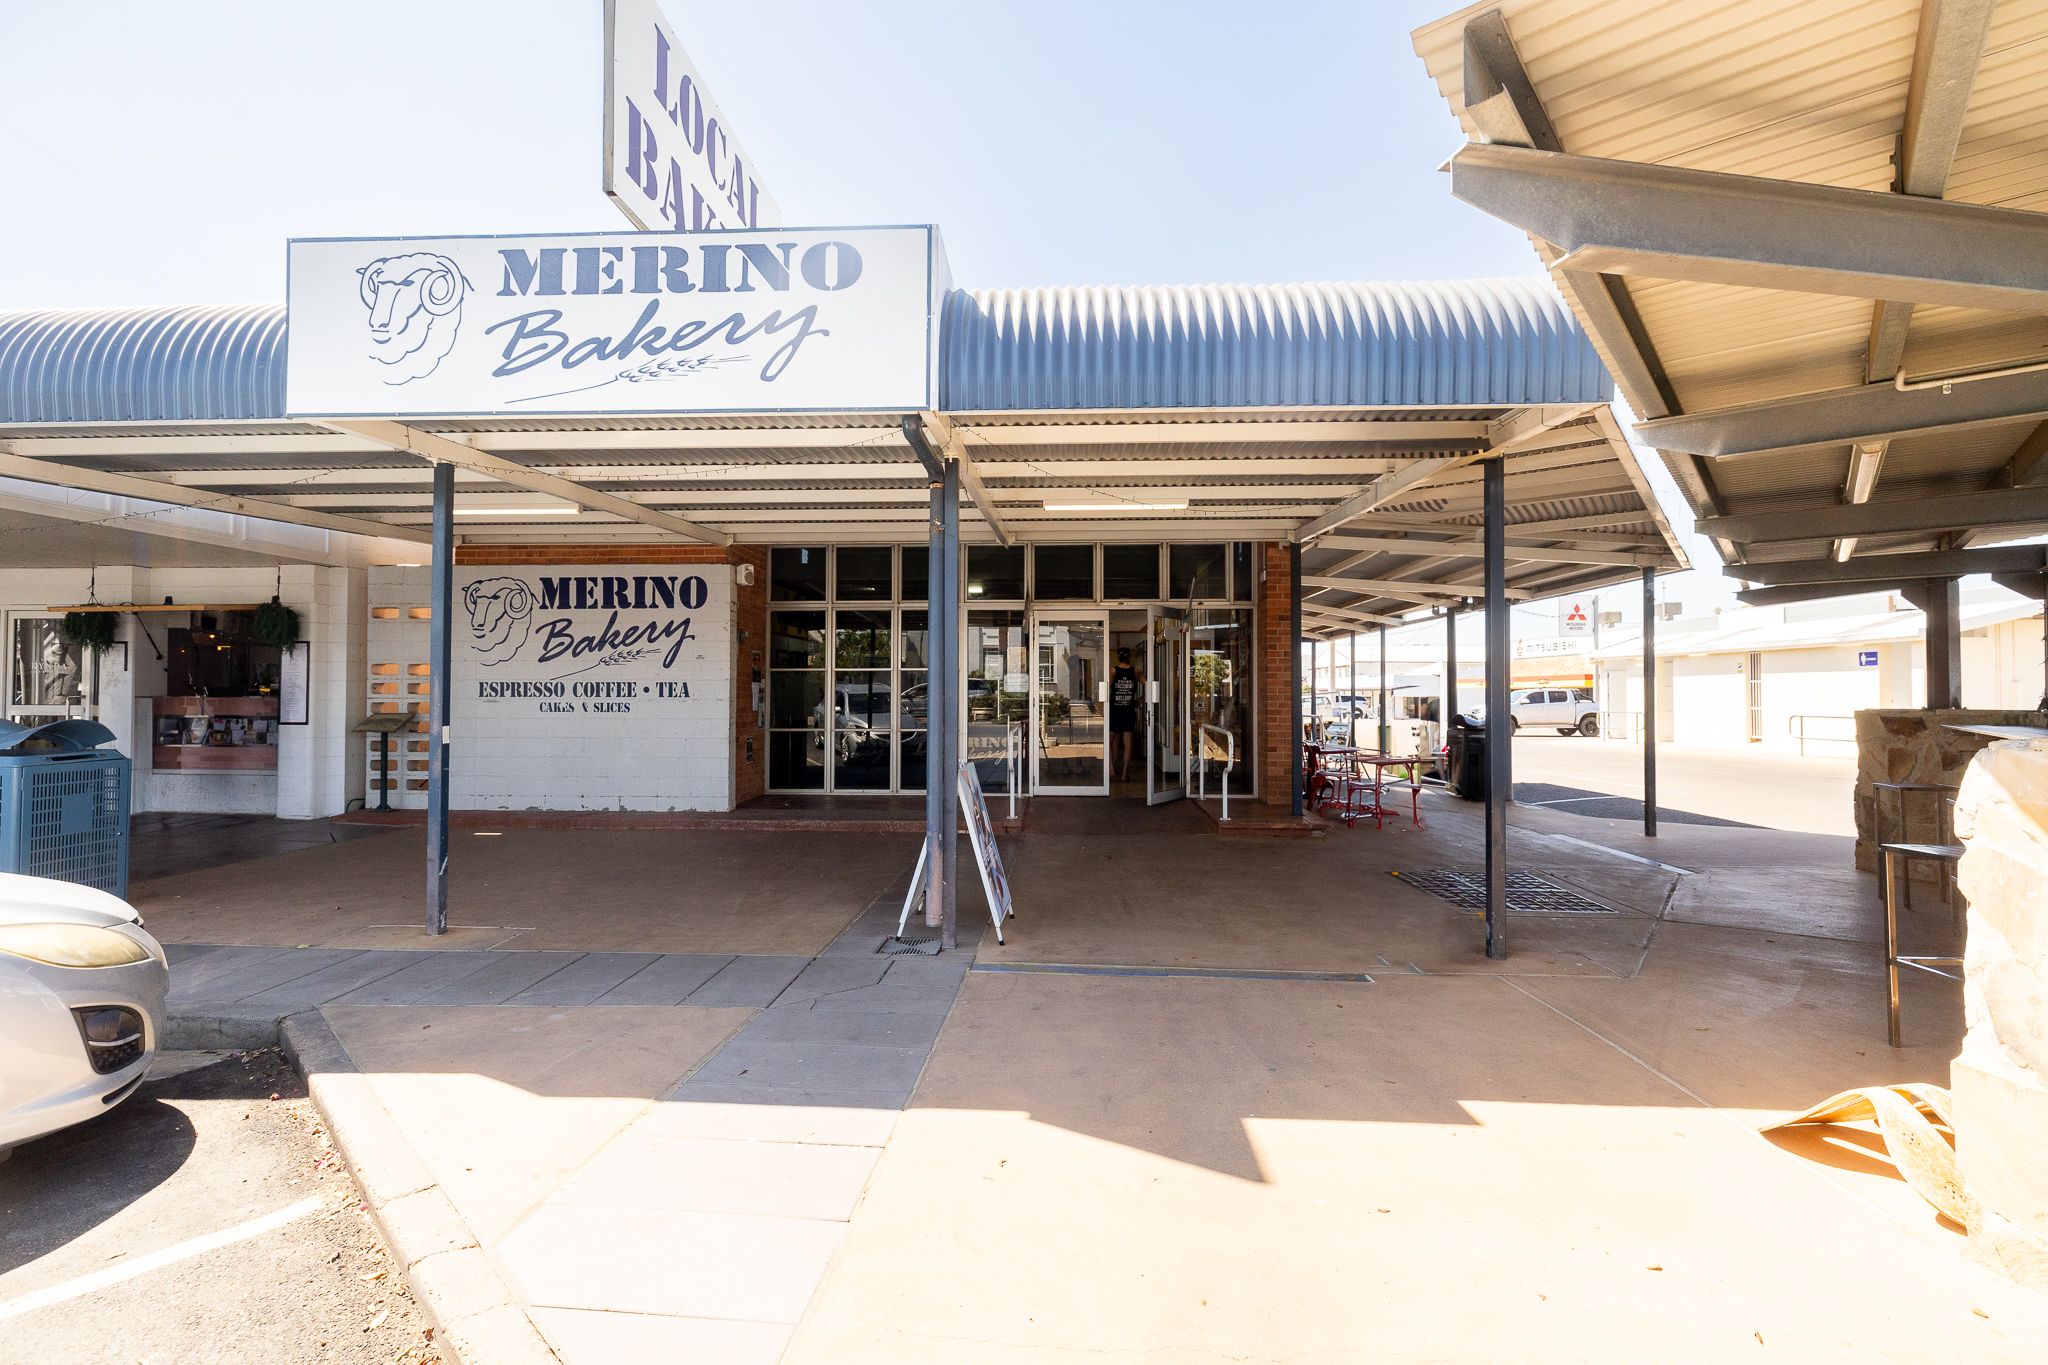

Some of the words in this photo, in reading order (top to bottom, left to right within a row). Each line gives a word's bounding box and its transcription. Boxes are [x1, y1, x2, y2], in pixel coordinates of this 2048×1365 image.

[496, 240, 863, 297] MERINO
[485, 298, 830, 382] Bakery
[539, 576, 709, 610] MERINO
[535, 609, 696, 669] Bakery
[1526, 641, 1577, 653] MITSUBISHI
[478, 681, 566, 698] ESPRESSO
[572, 681, 638, 698] COFFEE
[655, 681, 691, 698] TEA
[593, 702, 631, 713] SLICES
